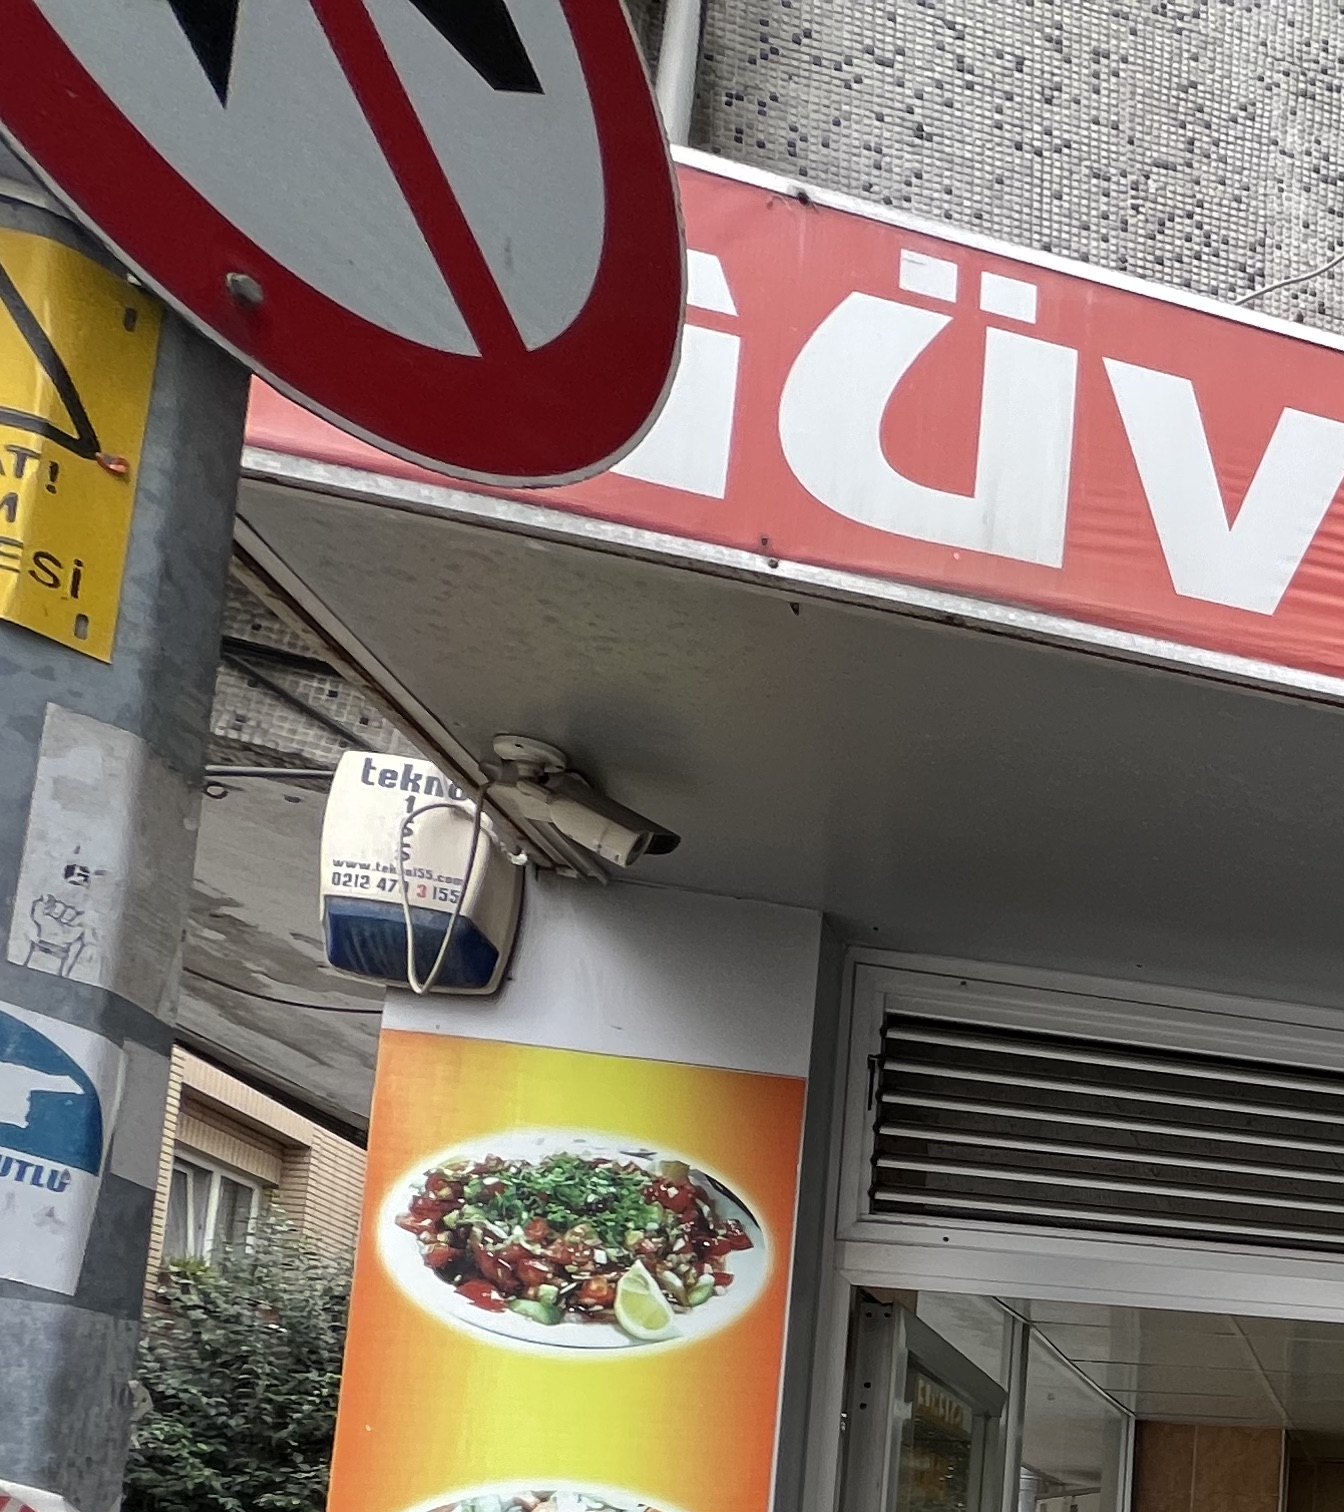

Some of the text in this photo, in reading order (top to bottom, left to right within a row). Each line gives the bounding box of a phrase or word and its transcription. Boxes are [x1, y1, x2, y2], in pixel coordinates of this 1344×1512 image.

[360, 757, 468, 801] tekno
[331, 871, 371, 889] 0212
[416, 884, 427, 898] 3
[432, 886, 461, 904] 155
